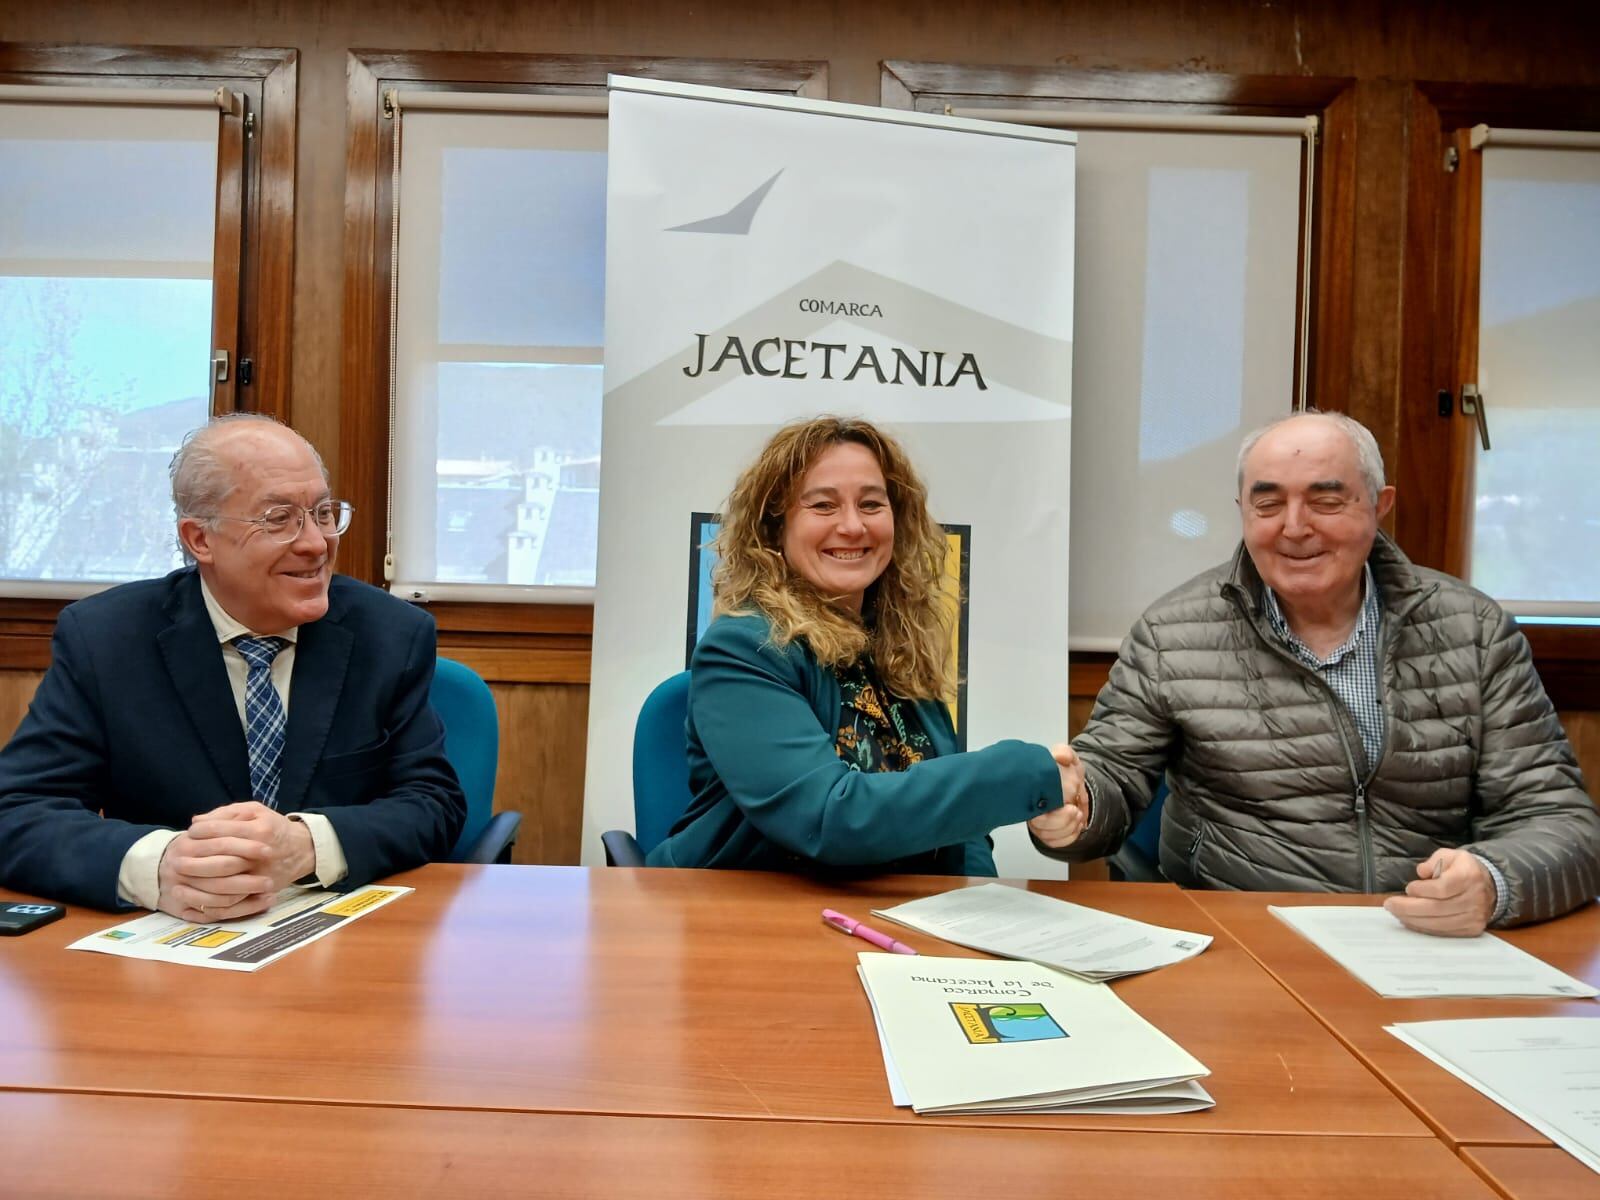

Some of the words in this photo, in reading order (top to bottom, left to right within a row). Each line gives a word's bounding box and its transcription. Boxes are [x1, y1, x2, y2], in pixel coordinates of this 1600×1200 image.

[799, 298, 883, 318] COMARCA
[682, 333, 988, 391] JACETANIA
[910, 975, 996, 988] Jacetania
[1004, 980, 1022, 988] la
